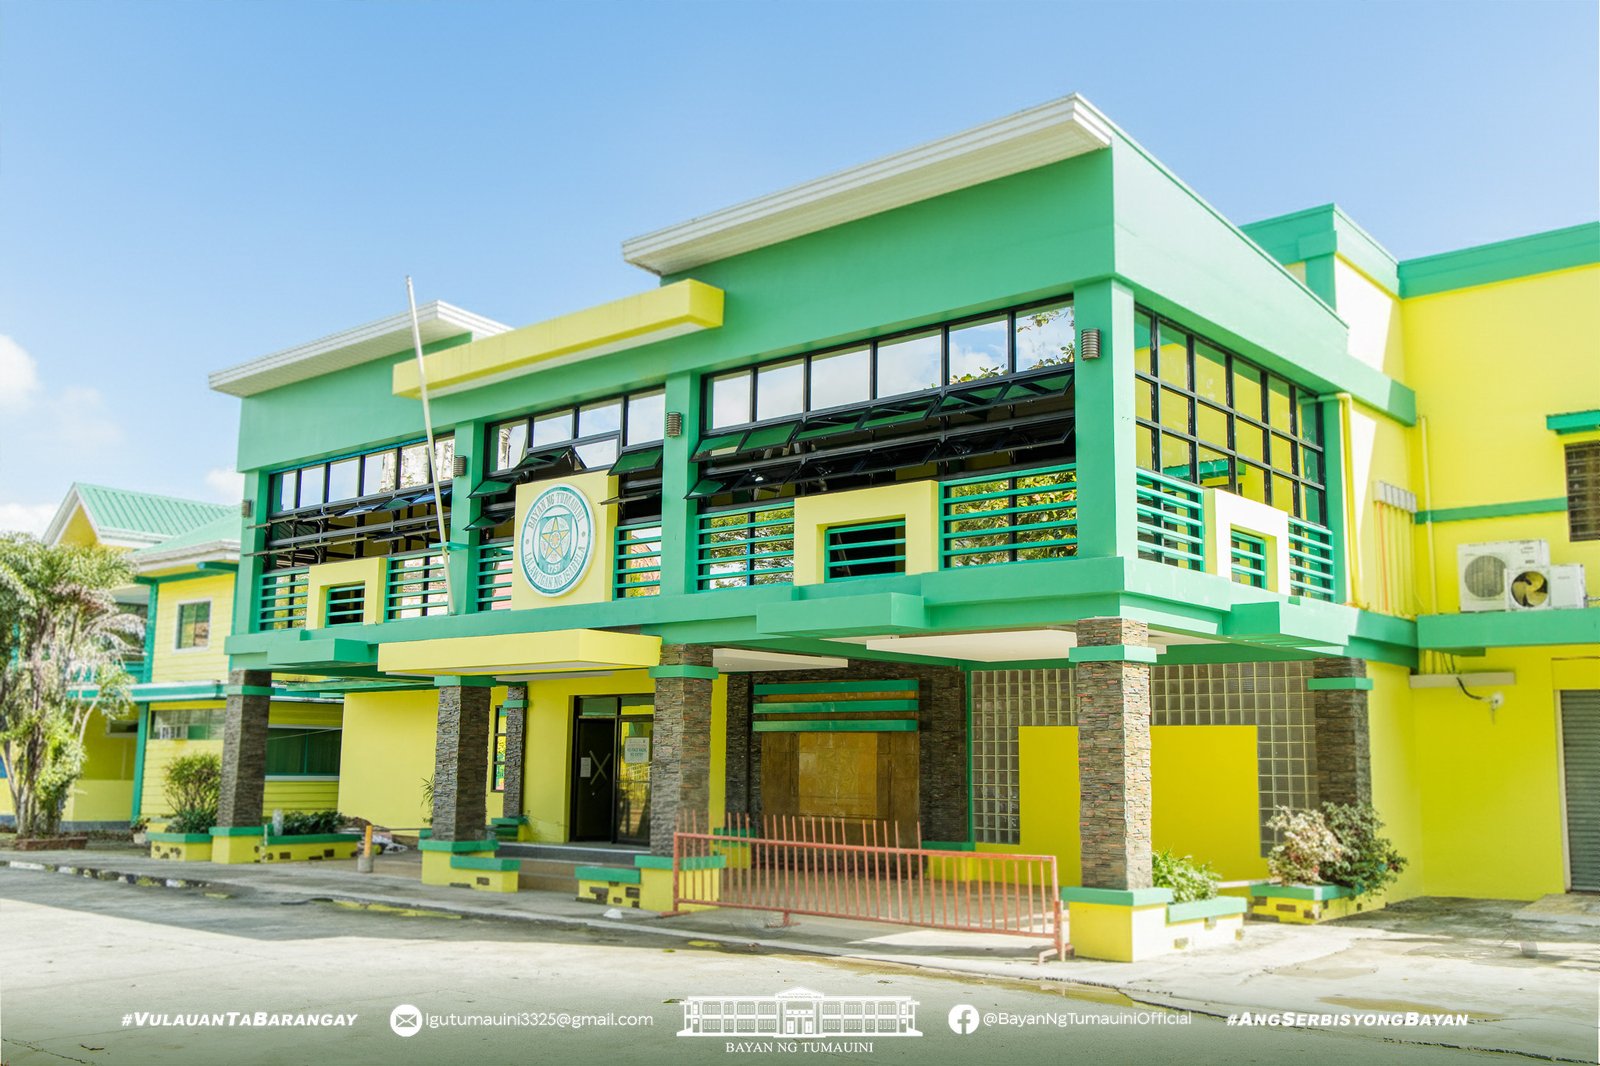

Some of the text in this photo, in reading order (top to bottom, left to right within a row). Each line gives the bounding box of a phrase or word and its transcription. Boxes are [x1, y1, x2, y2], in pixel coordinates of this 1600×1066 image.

[528, 492, 585, 529] BAYAN NG TUMAUINI
[525, 551, 553, 588] LALAWIGAN
[562, 546, 585, 582] ISABELA
